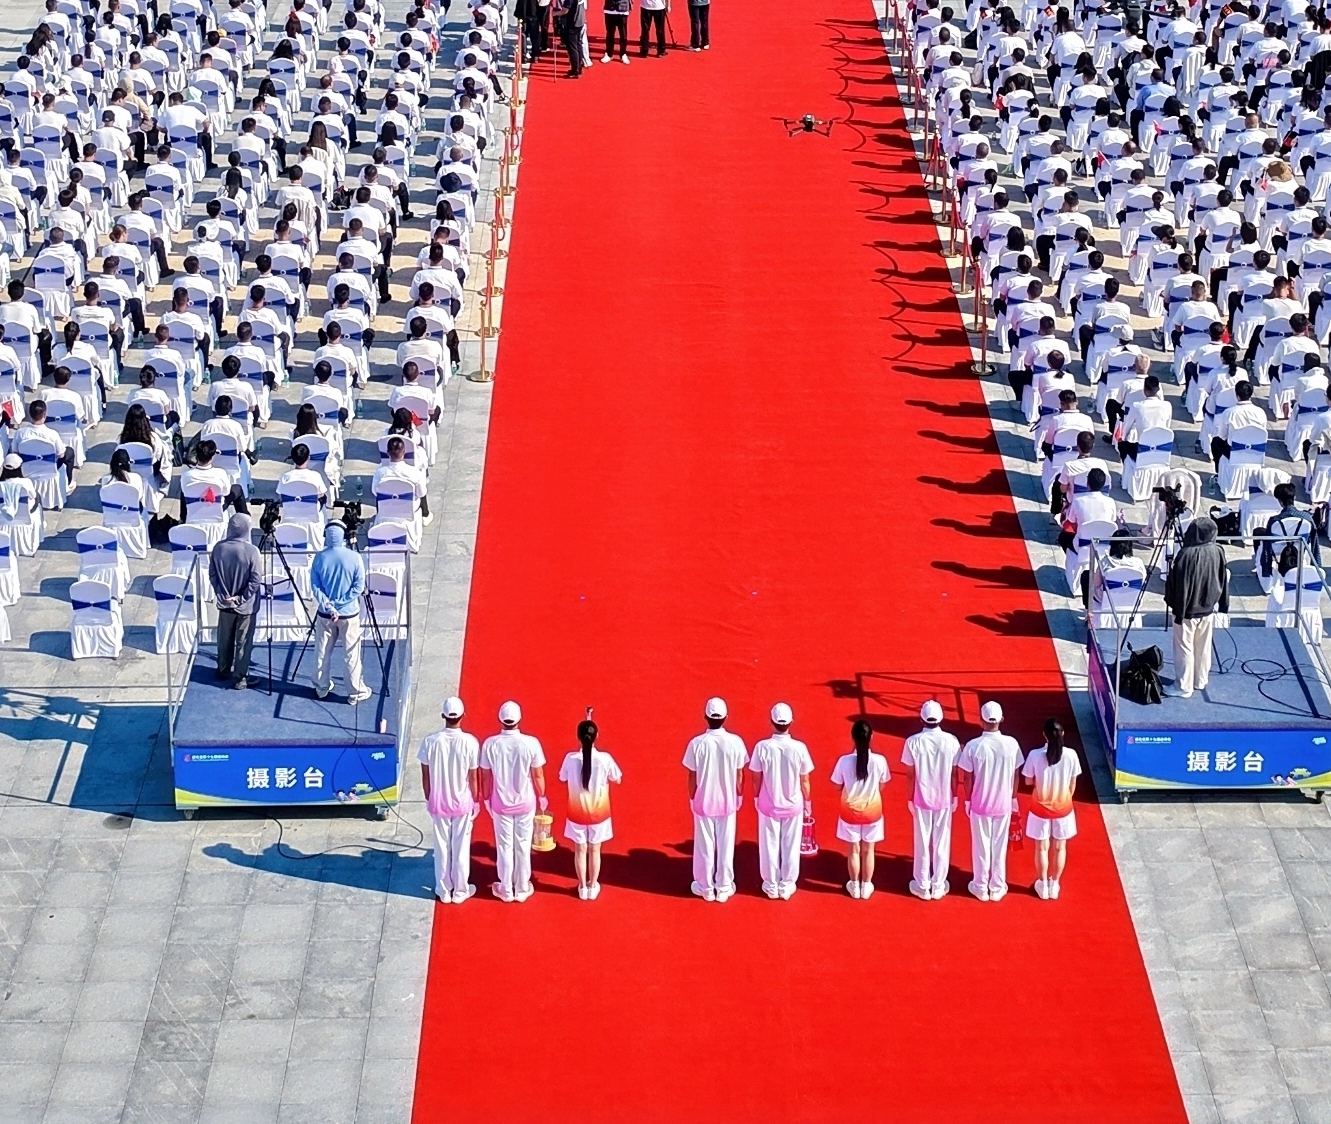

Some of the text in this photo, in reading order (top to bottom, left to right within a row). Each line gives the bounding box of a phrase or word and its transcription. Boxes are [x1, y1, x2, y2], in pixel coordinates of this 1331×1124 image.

[1186, 750, 1265, 773] 摄影台
[246, 767, 325, 790] 摄影台
